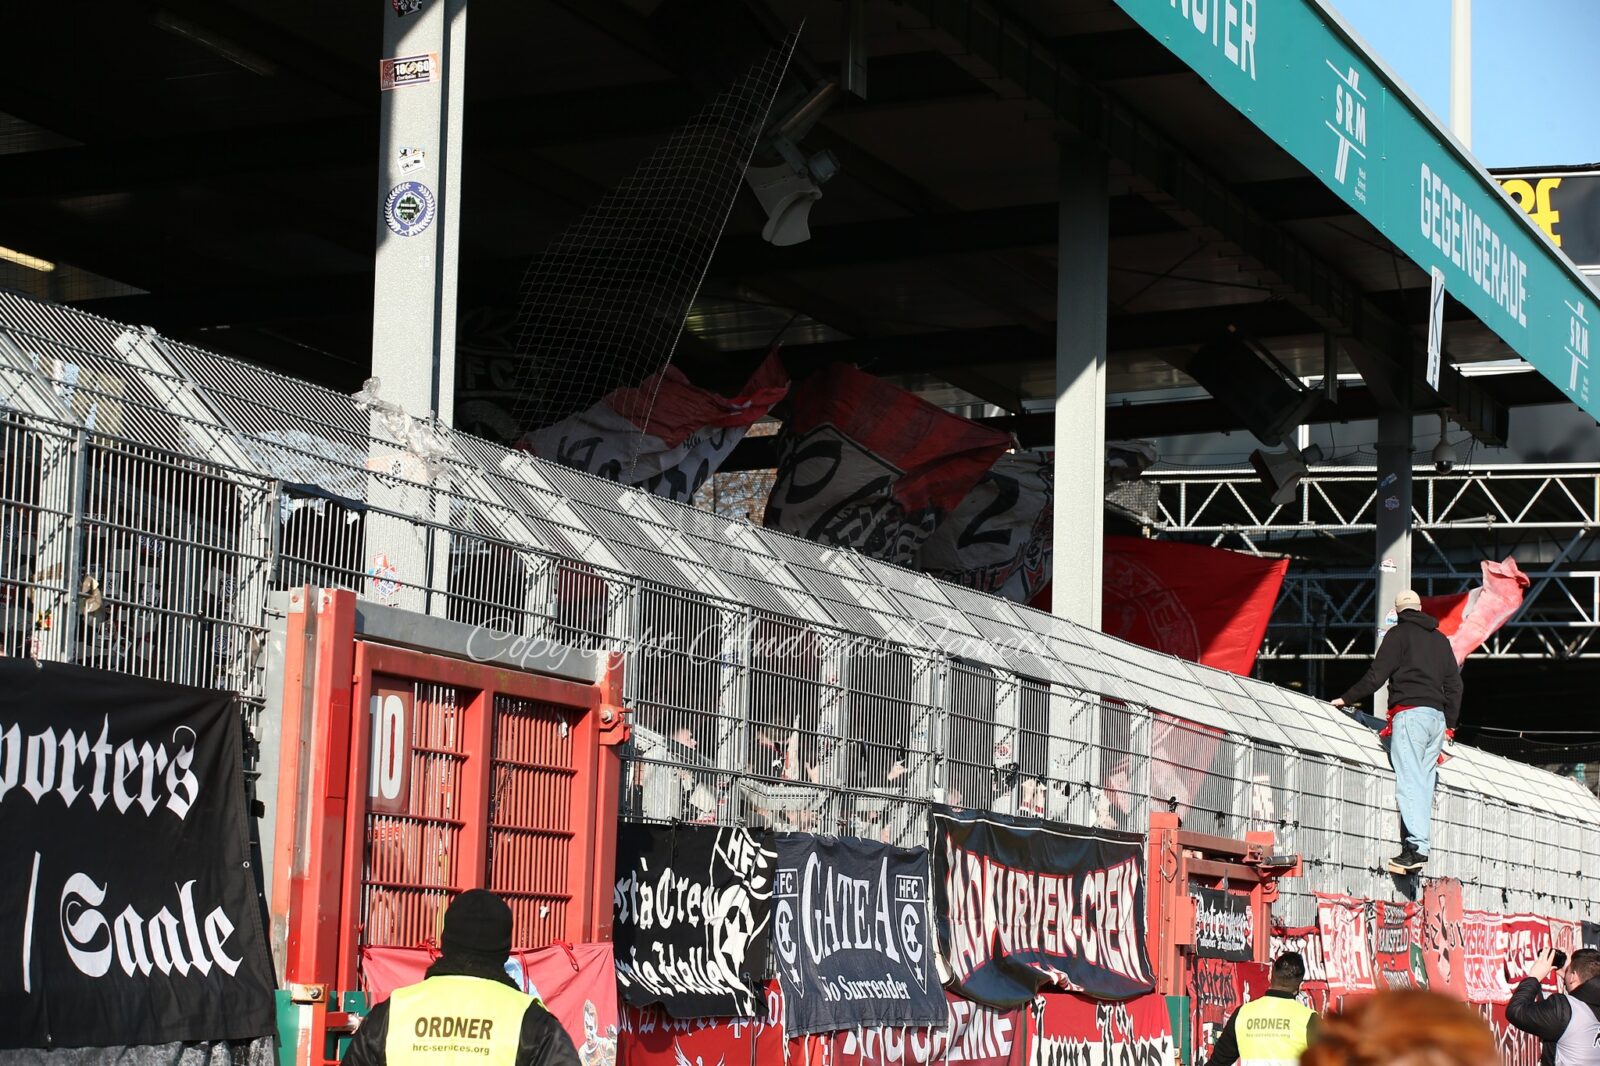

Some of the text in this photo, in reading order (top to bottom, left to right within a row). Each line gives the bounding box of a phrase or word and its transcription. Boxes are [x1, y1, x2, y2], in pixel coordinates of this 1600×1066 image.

[1335, 83, 1367, 148] SRM
[1420, 162, 1528, 329] GEGENGERADE
[1569, 315, 1589, 361] SRM
[370, 694, 405, 800] 10
[802, 851, 900, 965] GATE A
[899, 878, 918, 900] HFC
[60, 872, 244, 978] Saale
[838, 973, 911, 1000] Surrender
[415, 1016, 493, 1040] ORDNER
[1246, 1018, 1290, 1030] ORDNER
